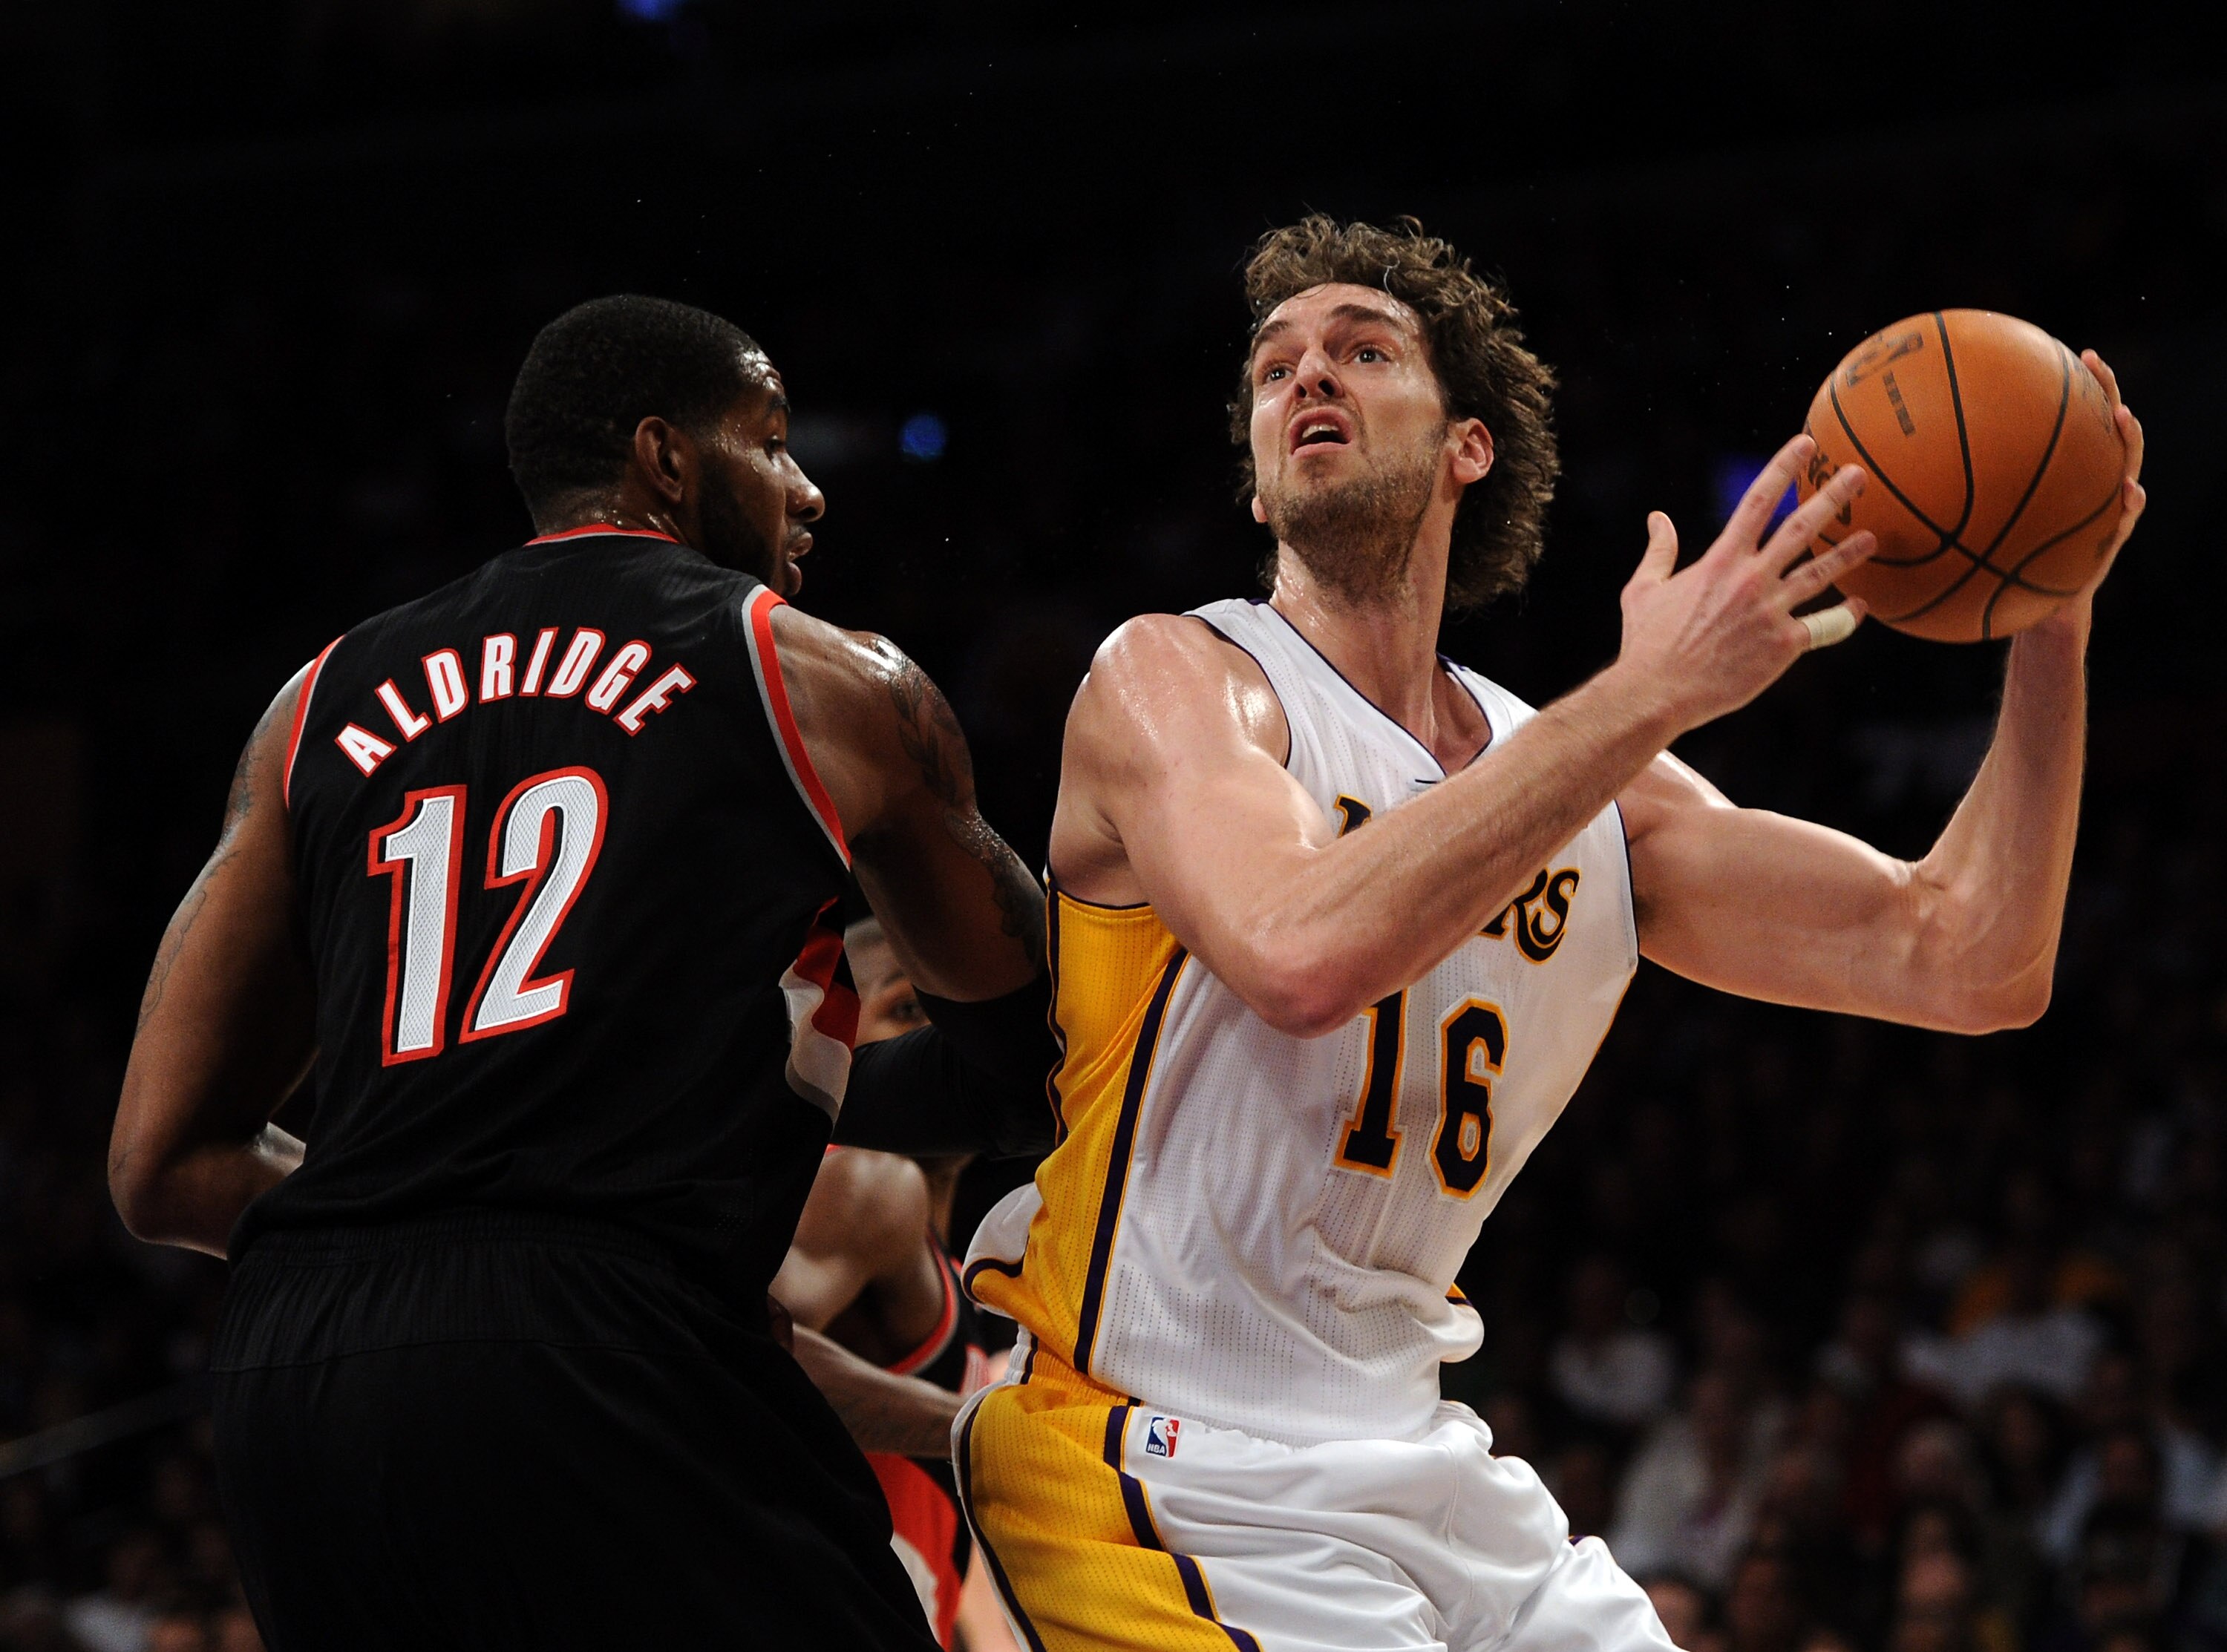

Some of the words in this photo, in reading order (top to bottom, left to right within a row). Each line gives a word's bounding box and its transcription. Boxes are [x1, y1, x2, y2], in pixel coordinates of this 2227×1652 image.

[335, 627, 697, 777] ALDRIDGE
[367, 766, 609, 1066] 12
[1334, 988, 1509, 1199] 16
[1147, 1443, 1165, 1455] NBA
